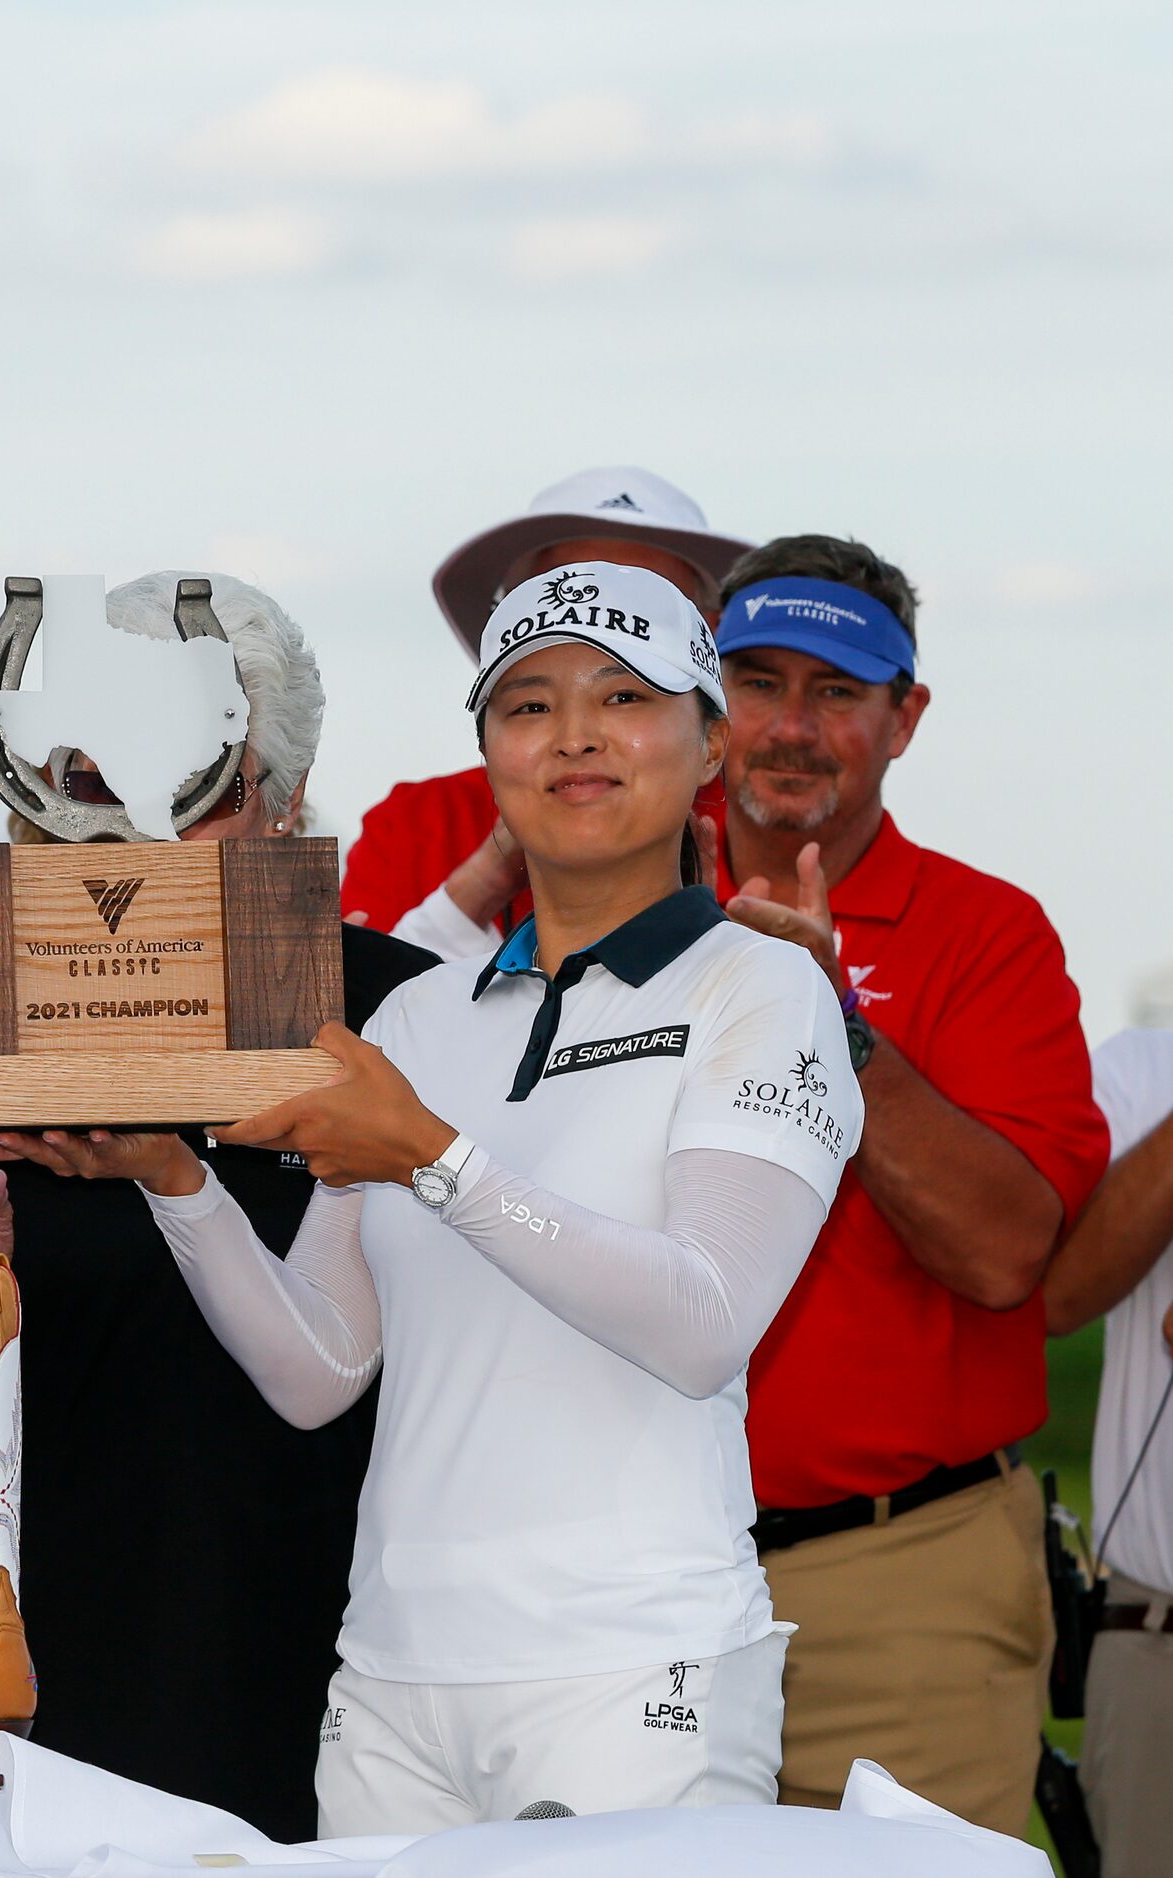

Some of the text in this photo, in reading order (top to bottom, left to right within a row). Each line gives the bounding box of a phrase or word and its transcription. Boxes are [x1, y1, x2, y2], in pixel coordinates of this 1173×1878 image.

[500, 606, 651, 653] SOLAIRE
[26, 938, 202, 956] Volunteers of America
[69, 957, 161, 977] CLASSIC
[27, 999, 208, 1020] 2021 CHAMPION
[547, 1031, 685, 1071] LG SIGNATURE
[738, 1079, 844, 1149] SOLAIRE
[732, 1100, 839, 1160] RESORT & CASINO
[500, 1194, 561, 1241] LPGA
[643, 1718, 699, 1734] GOLF WEAR
[644, 1702, 698, 1723] LPGA
